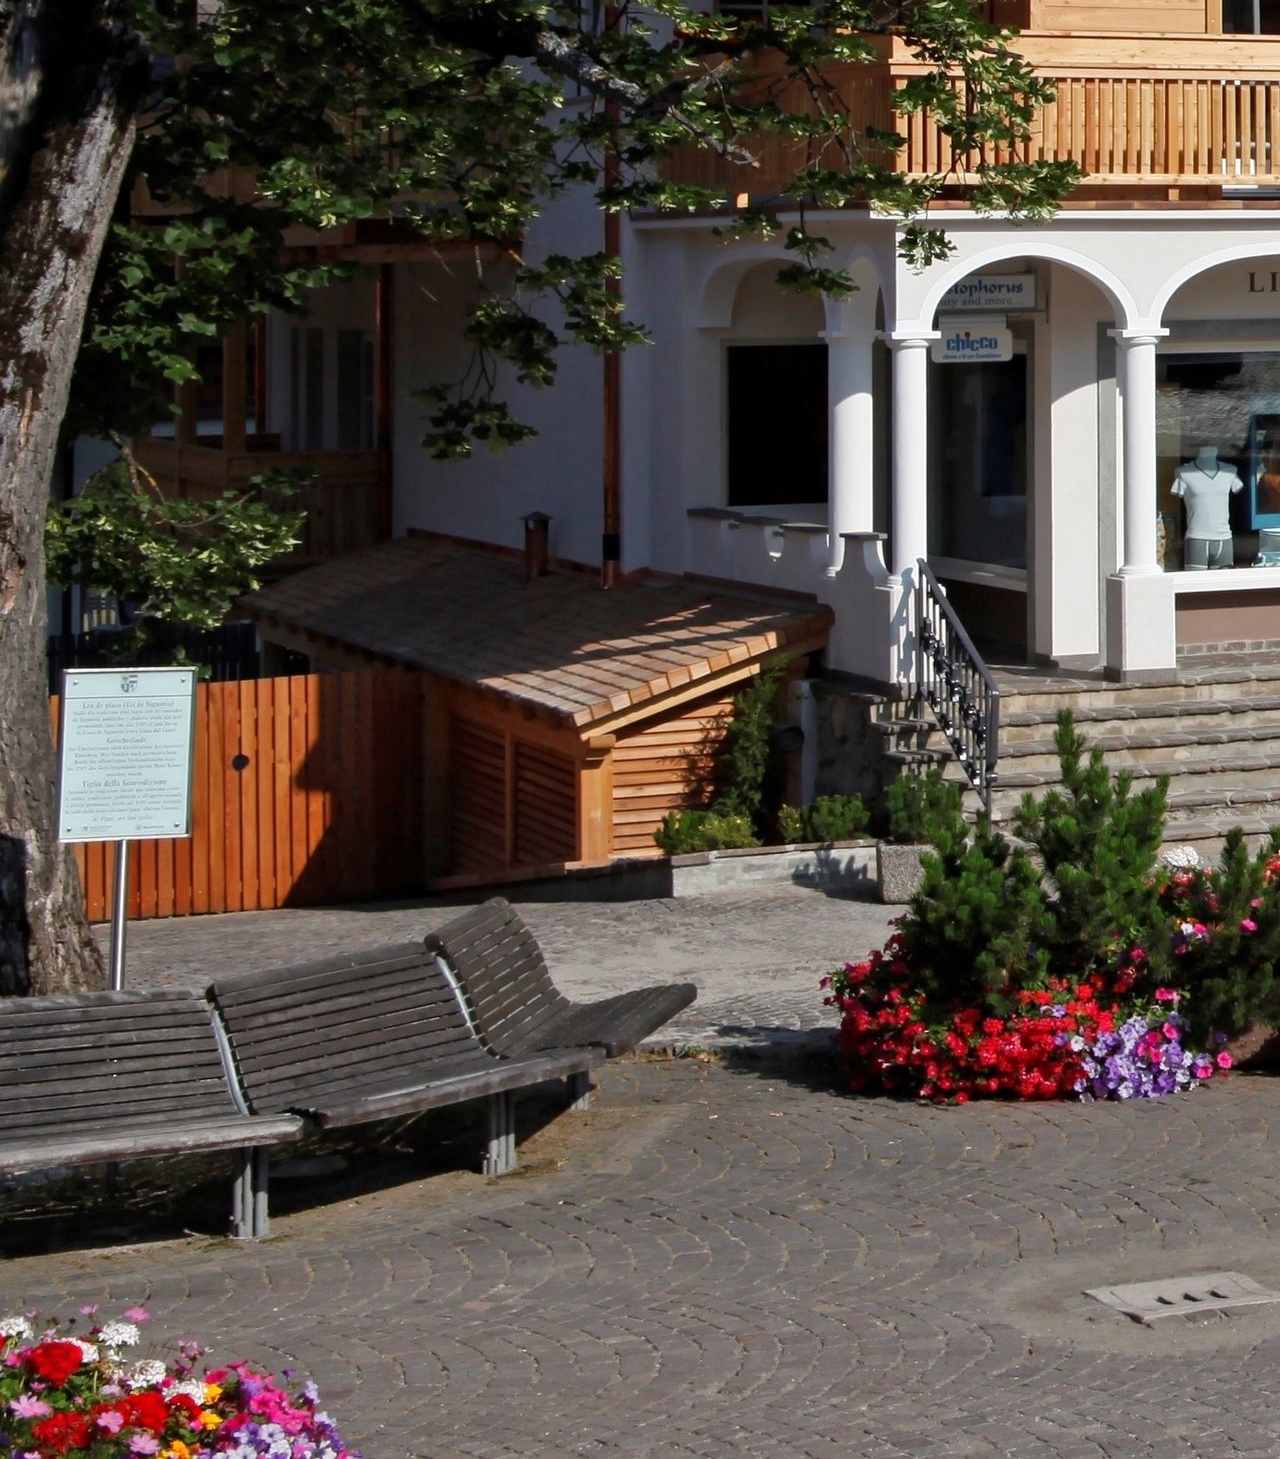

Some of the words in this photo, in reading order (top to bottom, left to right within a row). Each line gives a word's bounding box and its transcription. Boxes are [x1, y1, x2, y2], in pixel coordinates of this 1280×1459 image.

[947, 279, 1024, 297] tophorus
[961, 297, 981, 306] and
[946, 331, 998, 351] chicco
